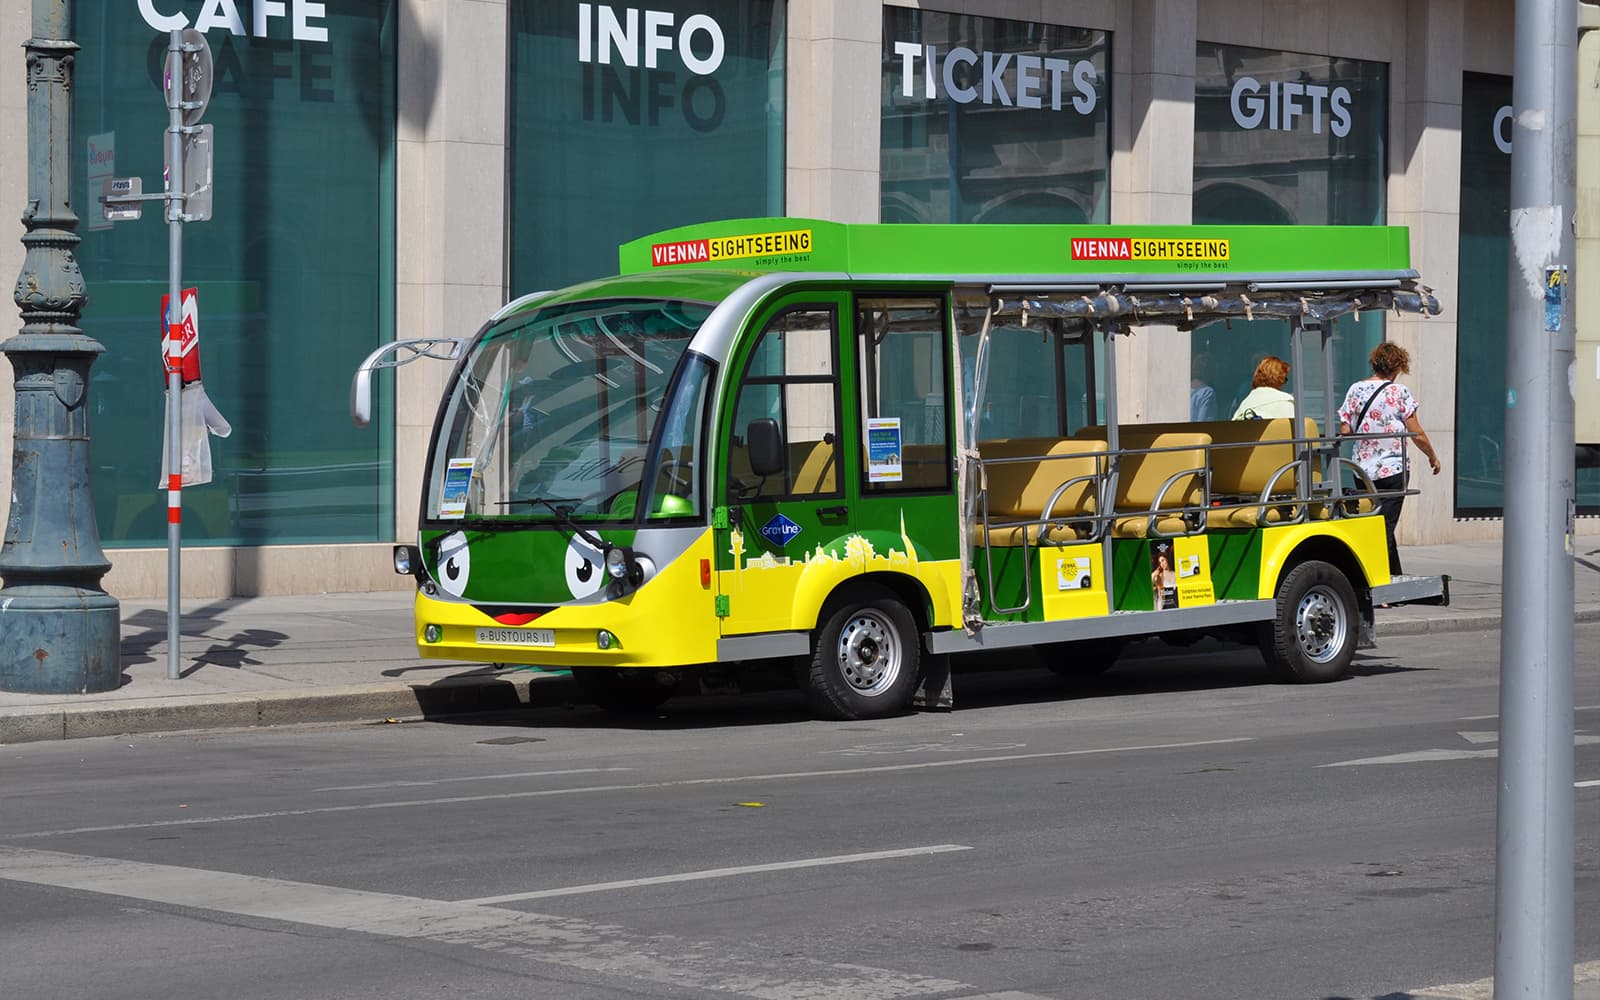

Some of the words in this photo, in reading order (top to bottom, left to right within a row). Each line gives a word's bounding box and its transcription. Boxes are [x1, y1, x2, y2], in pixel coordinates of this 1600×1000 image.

[137, 0, 329, 42] CAFE
[578, 2, 726, 76] INFO
[894, 41, 1098, 115] TICKETS
[1230, 76, 1352, 138] GIFTS
[653, 242, 709, 264] VIENNA
[711, 233, 810, 258] SIGHTSEEING
[755, 256, 779, 266] simply
[780, 255, 792, 264] the
[794, 254, 811, 263] best
[1072, 240, 1130, 258] VIENNA
[1133, 241, 1228, 258] SIGHTSEEING
[1177, 261, 1199, 271] simply
[1200, 261, 1212, 269] the
[1213, 261, 1229, 269] best
[479, 630, 539, 643] e-BUSTOURS
